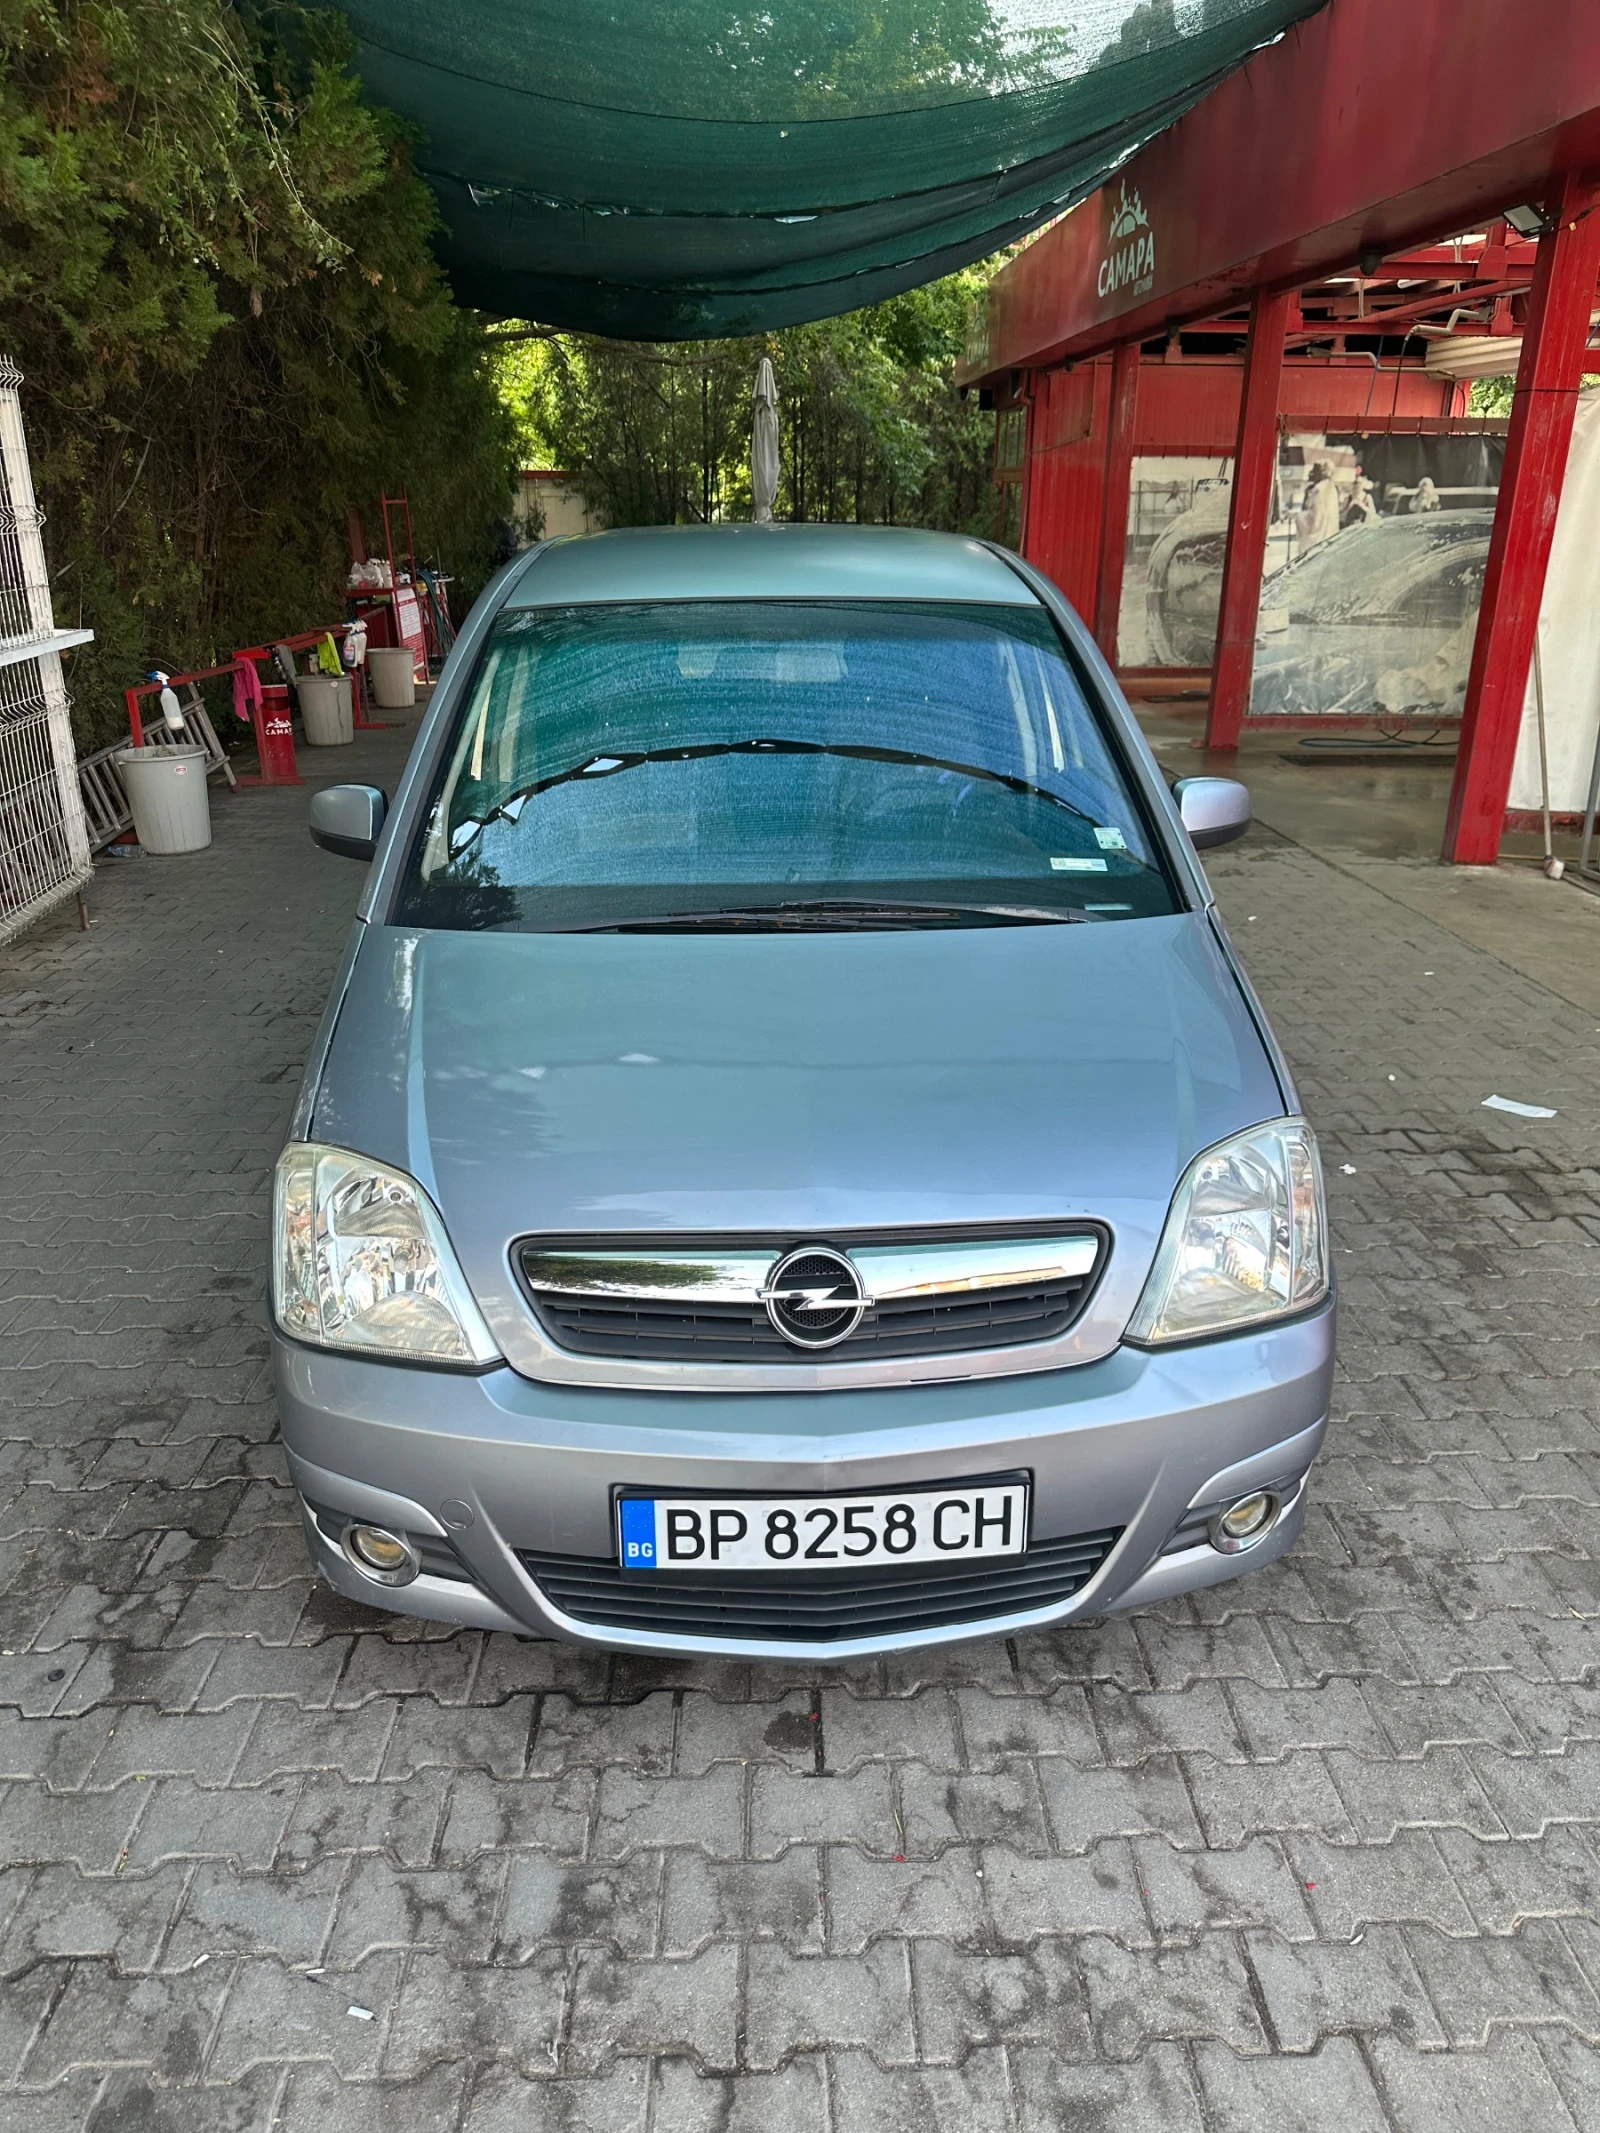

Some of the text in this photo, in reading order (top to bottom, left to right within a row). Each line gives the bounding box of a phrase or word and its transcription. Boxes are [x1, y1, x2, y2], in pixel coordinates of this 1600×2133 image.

[1097, 231, 1155, 298] САМАРА
[627, 1542, 653, 1558] BG
[666, 1495, 1011, 1560] BP 8258 CH
